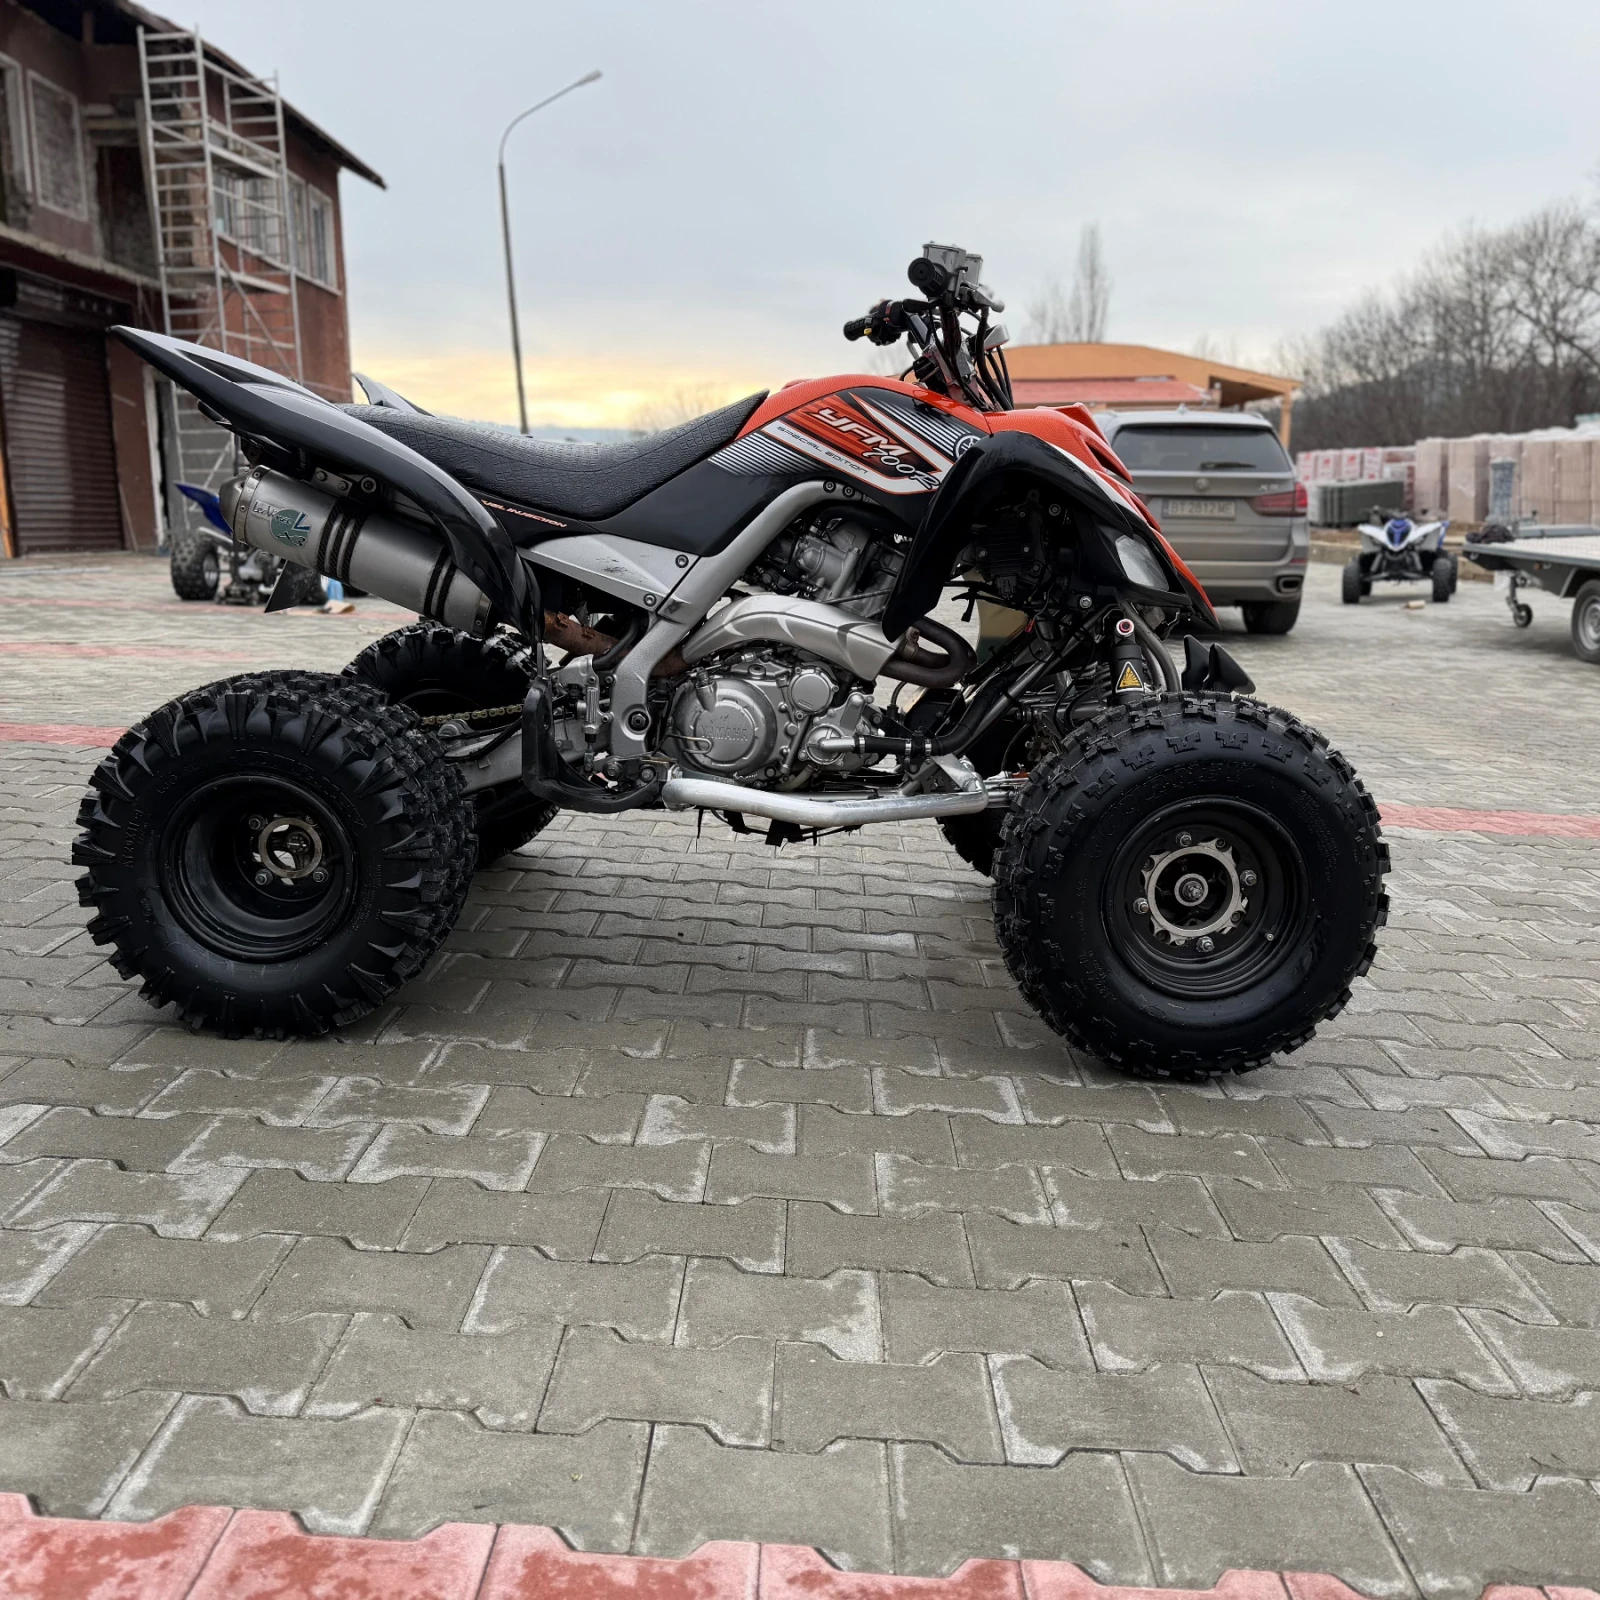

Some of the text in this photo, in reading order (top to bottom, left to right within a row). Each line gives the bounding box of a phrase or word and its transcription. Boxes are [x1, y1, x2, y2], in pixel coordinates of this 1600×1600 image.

[776, 426, 869, 475] SPECIAL EDITION
[808, 407, 941, 490] YFM 700R
[506, 507, 568, 528] INJECTION
[700, 724, 749, 742] YAMAHA
